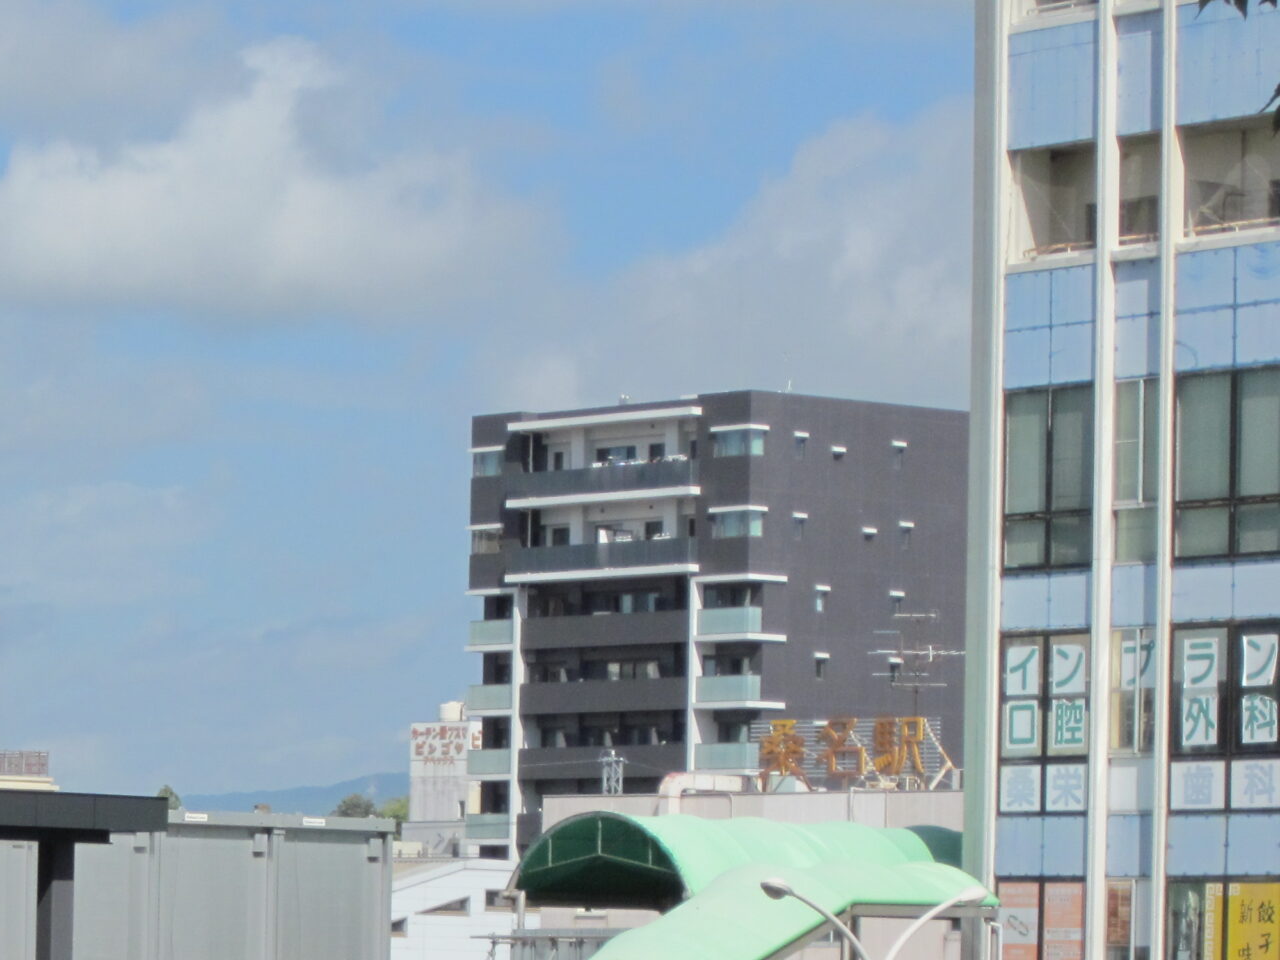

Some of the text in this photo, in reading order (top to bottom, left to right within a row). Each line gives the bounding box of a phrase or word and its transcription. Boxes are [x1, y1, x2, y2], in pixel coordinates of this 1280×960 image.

[1008, 695, 1277, 745] 口腔外科
[758, 717, 925, 778] 桑名駅
[1006, 763, 1276, 806] 桑栄歯科
[1257, 900, 1276, 955] 餃子
